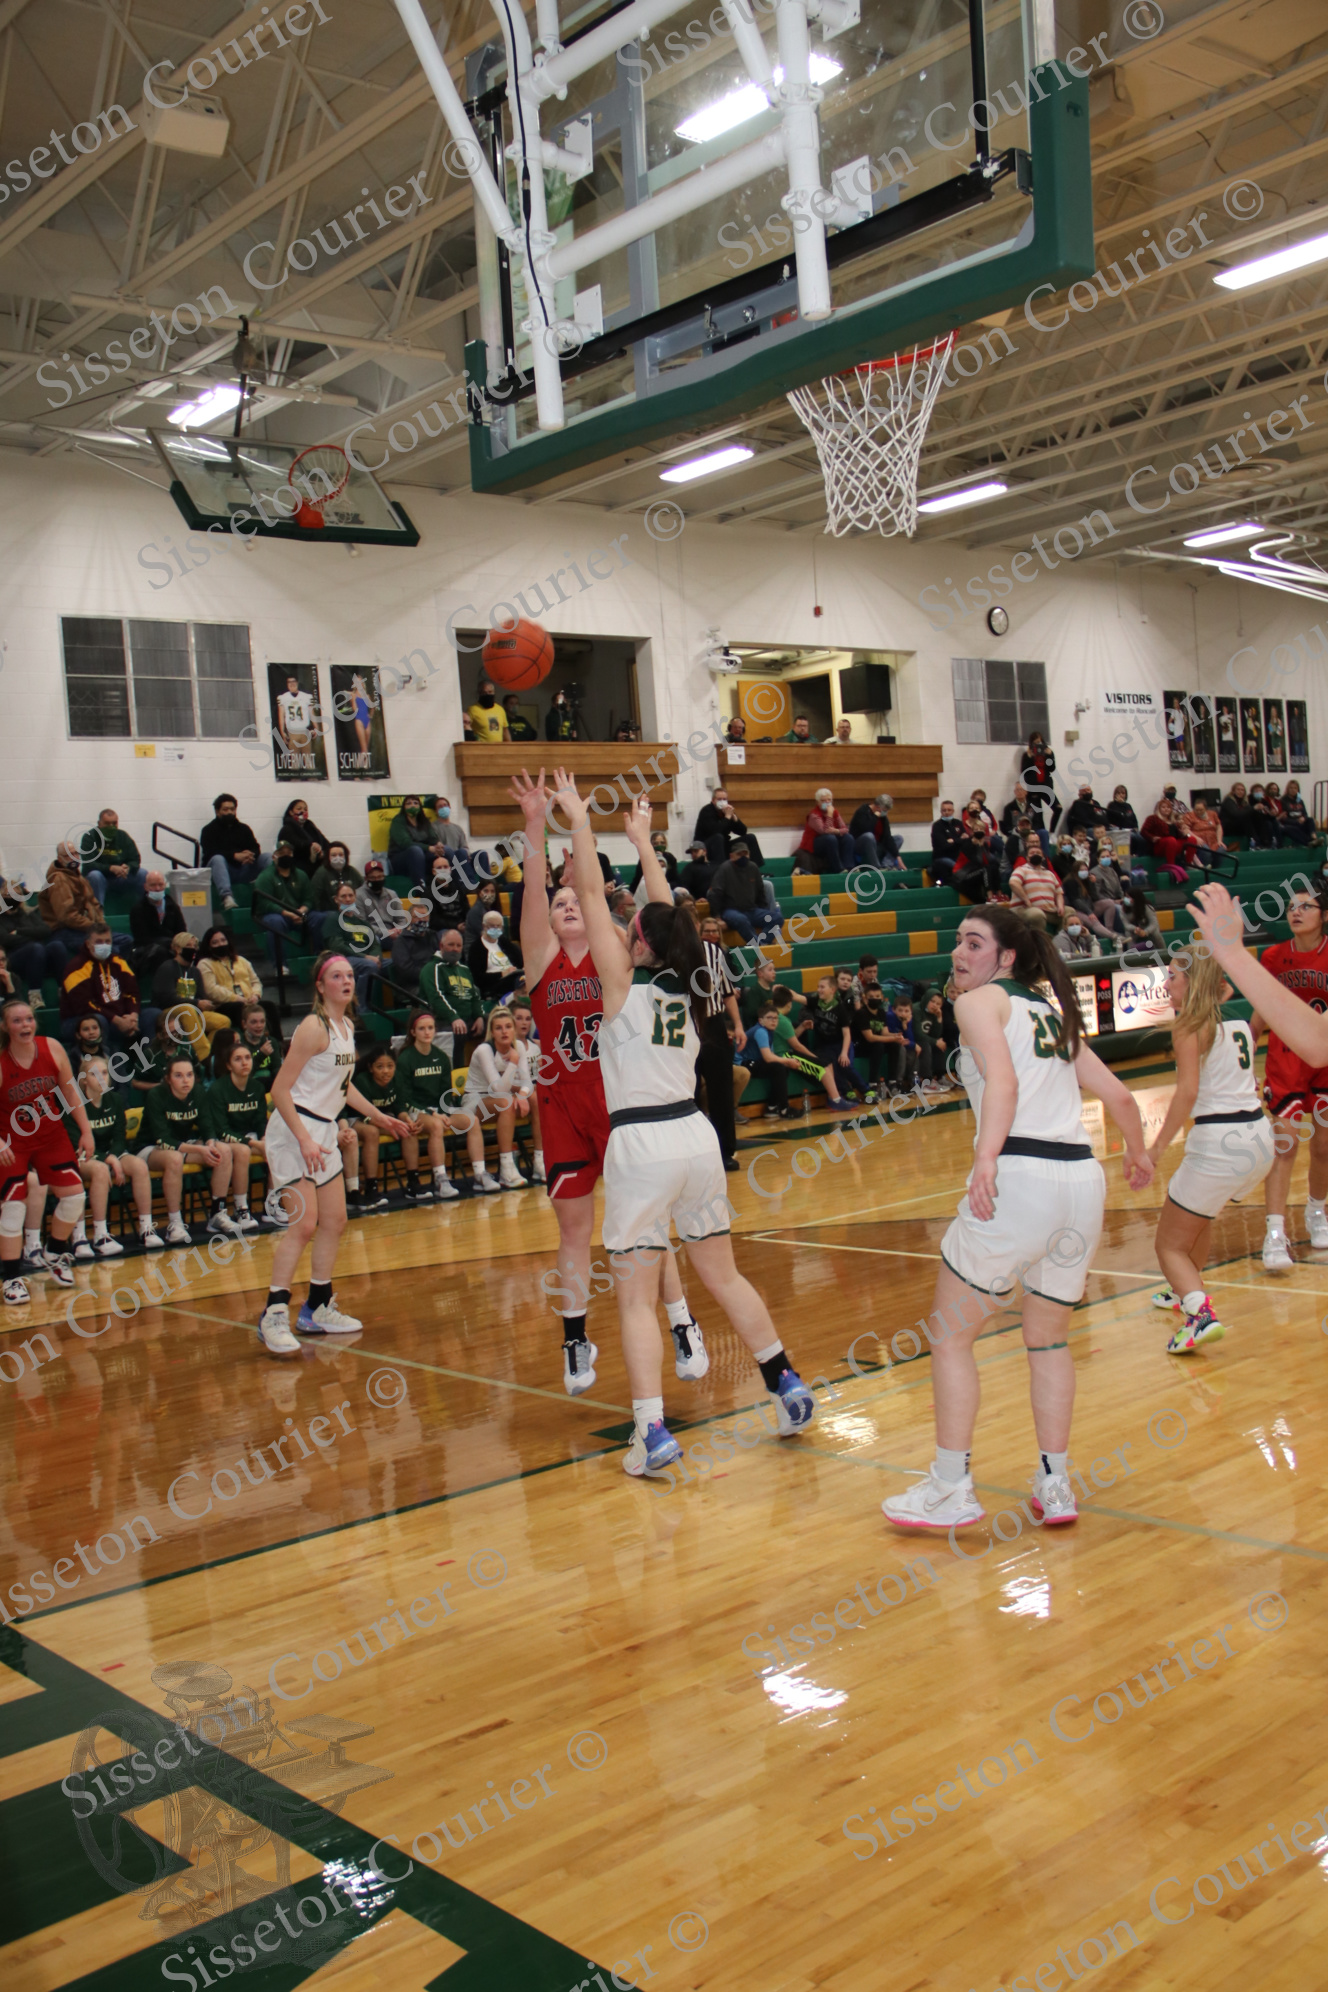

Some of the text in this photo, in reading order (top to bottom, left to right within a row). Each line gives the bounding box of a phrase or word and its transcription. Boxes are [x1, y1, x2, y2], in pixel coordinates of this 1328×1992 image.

[1105, 692, 1152, 705] VISITORS
[287, 705, 304, 721] 54
[277, 753, 316, 769] LIVERMONT
[1097, 990, 1112, 1000] POSS
[651, 998, 686, 1048] 12
[558, 1012, 604, 1063] 42
[1232, 1031, 1250, 1070] 3
[8, 1075, 57, 1102] SISSETON
[340, 1070, 351, 1098] 4
